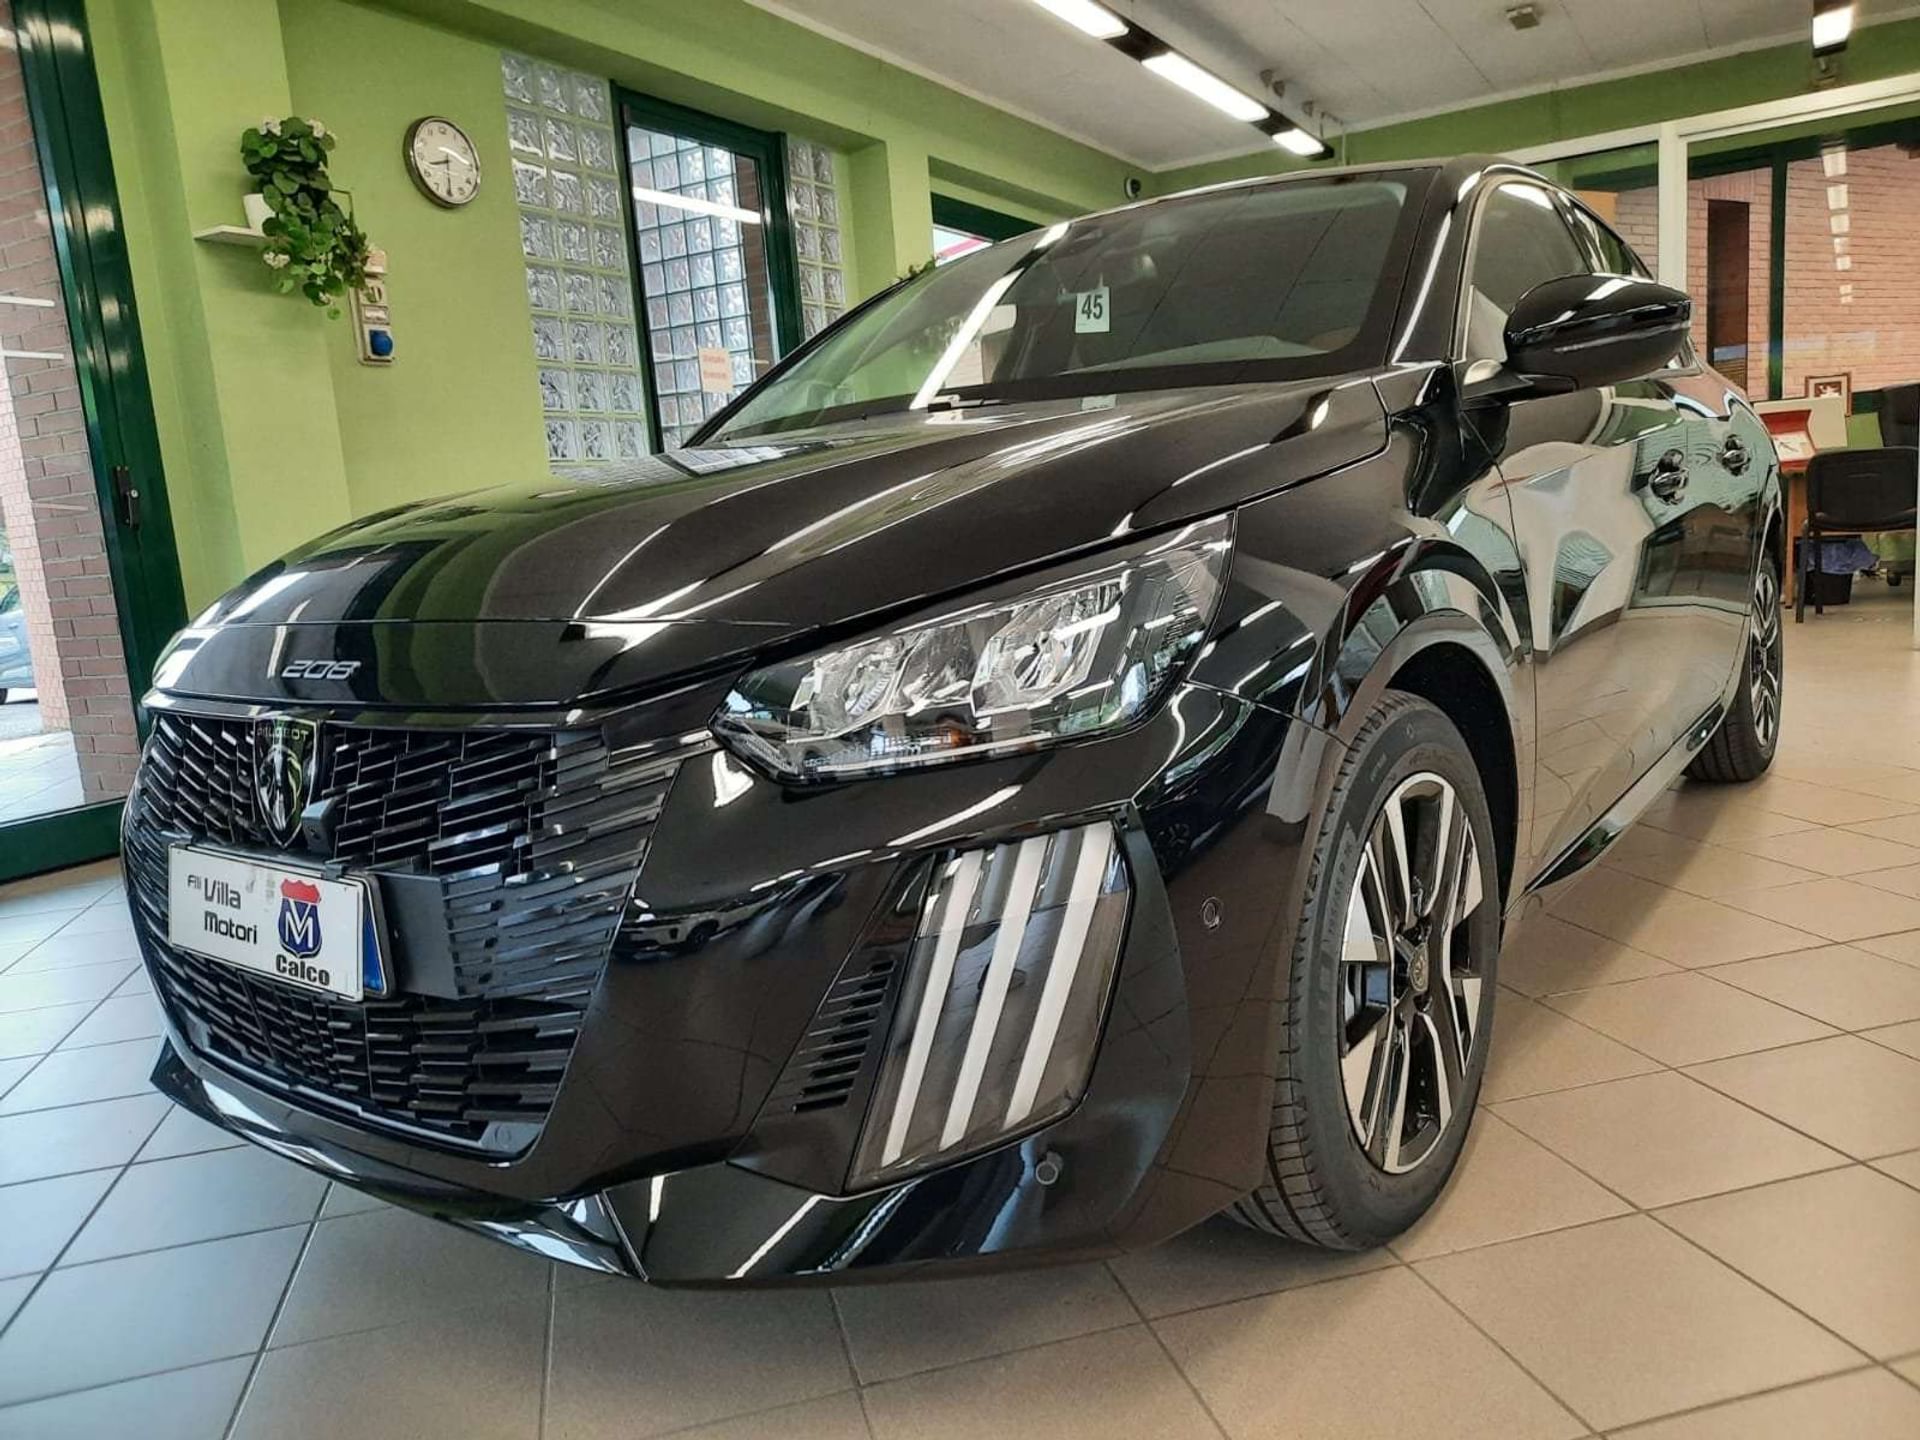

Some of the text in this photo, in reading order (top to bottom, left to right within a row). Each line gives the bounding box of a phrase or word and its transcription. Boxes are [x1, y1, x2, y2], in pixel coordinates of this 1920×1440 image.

[1081, 294, 1103, 320] 45
[281, 660, 361, 679] 208
[204, 877, 241, 910] Villa
[204, 910, 257, 945] Motori
[275, 953, 330, 987] Calco
